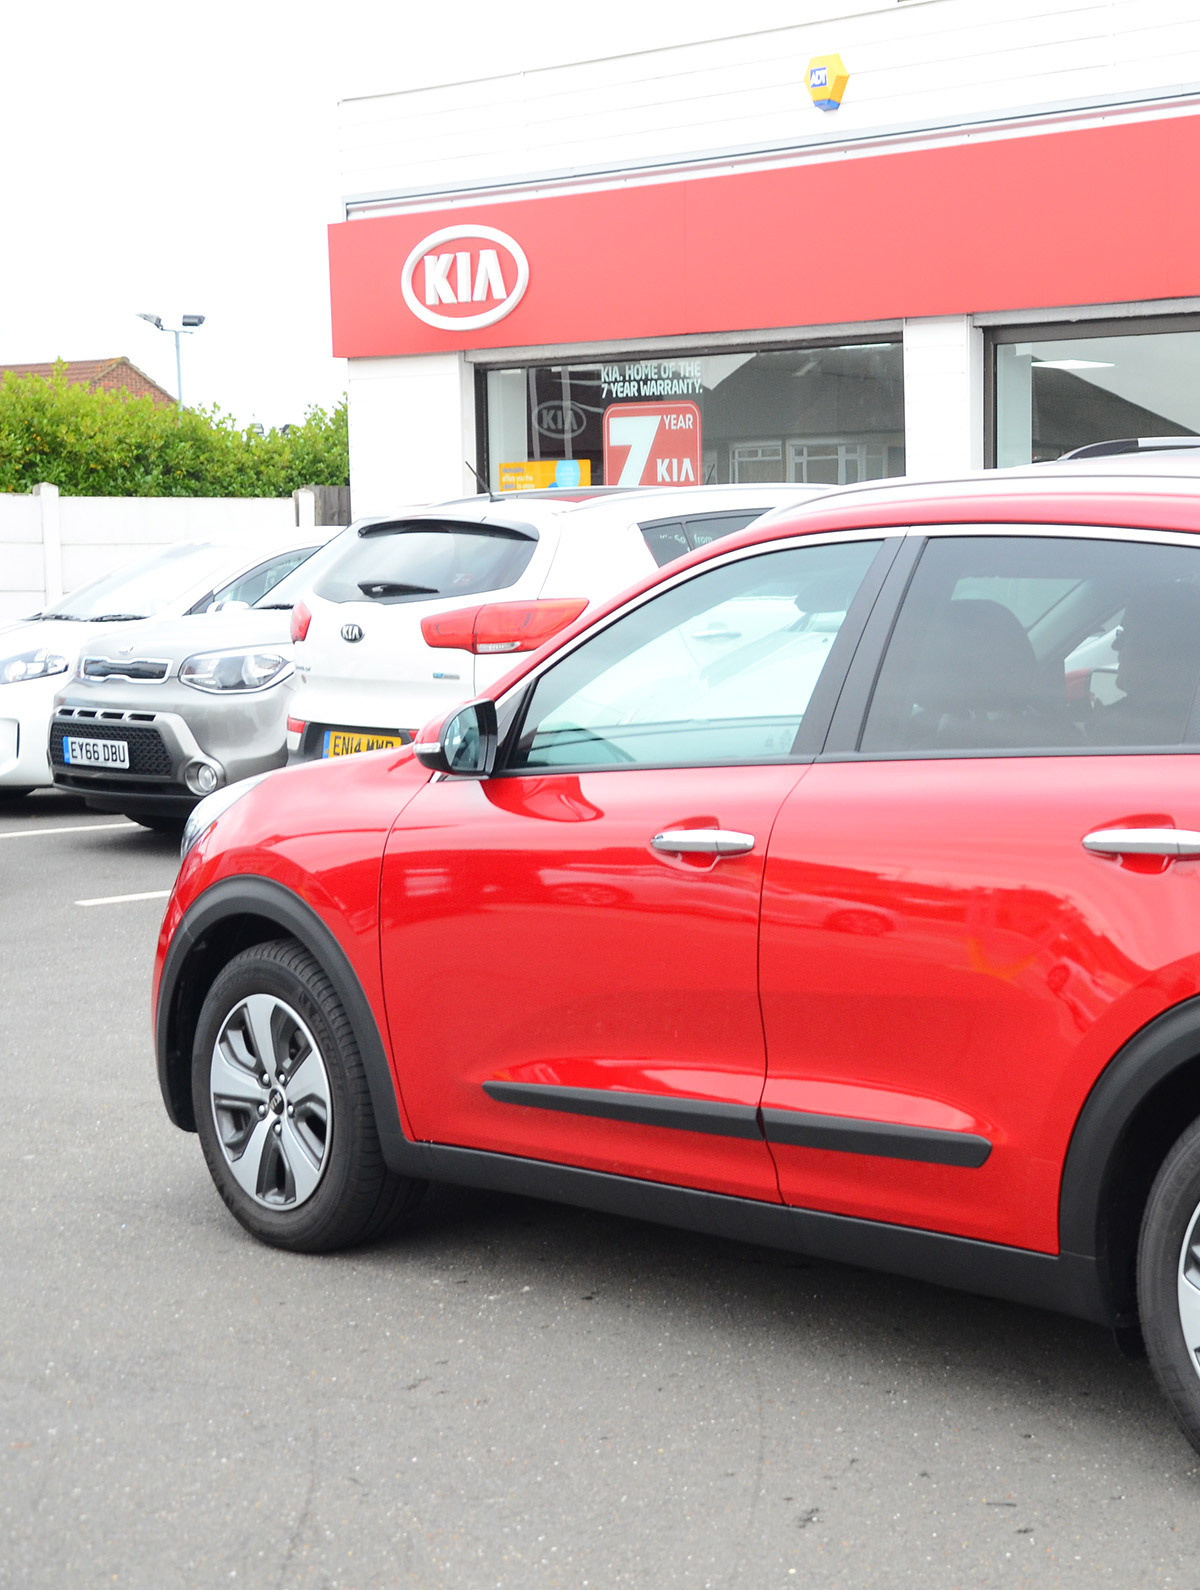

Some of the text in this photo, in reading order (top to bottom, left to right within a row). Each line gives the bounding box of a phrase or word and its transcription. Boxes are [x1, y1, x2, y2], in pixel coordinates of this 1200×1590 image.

[424, 249, 507, 306] KIA
[601, 360, 701, 382] KIA. HOME OF THE
[601, 378, 703, 399] 7 YEAR WARRANTY.
[541, 408, 578, 430] KIA
[663, 413, 693, 430] YEAR
[656, 457, 695, 483] KIA
[342, 625, 361, 640] KIA
[70, 741, 126, 762] EY66 DBU
[333, 735, 362, 756] EN14
